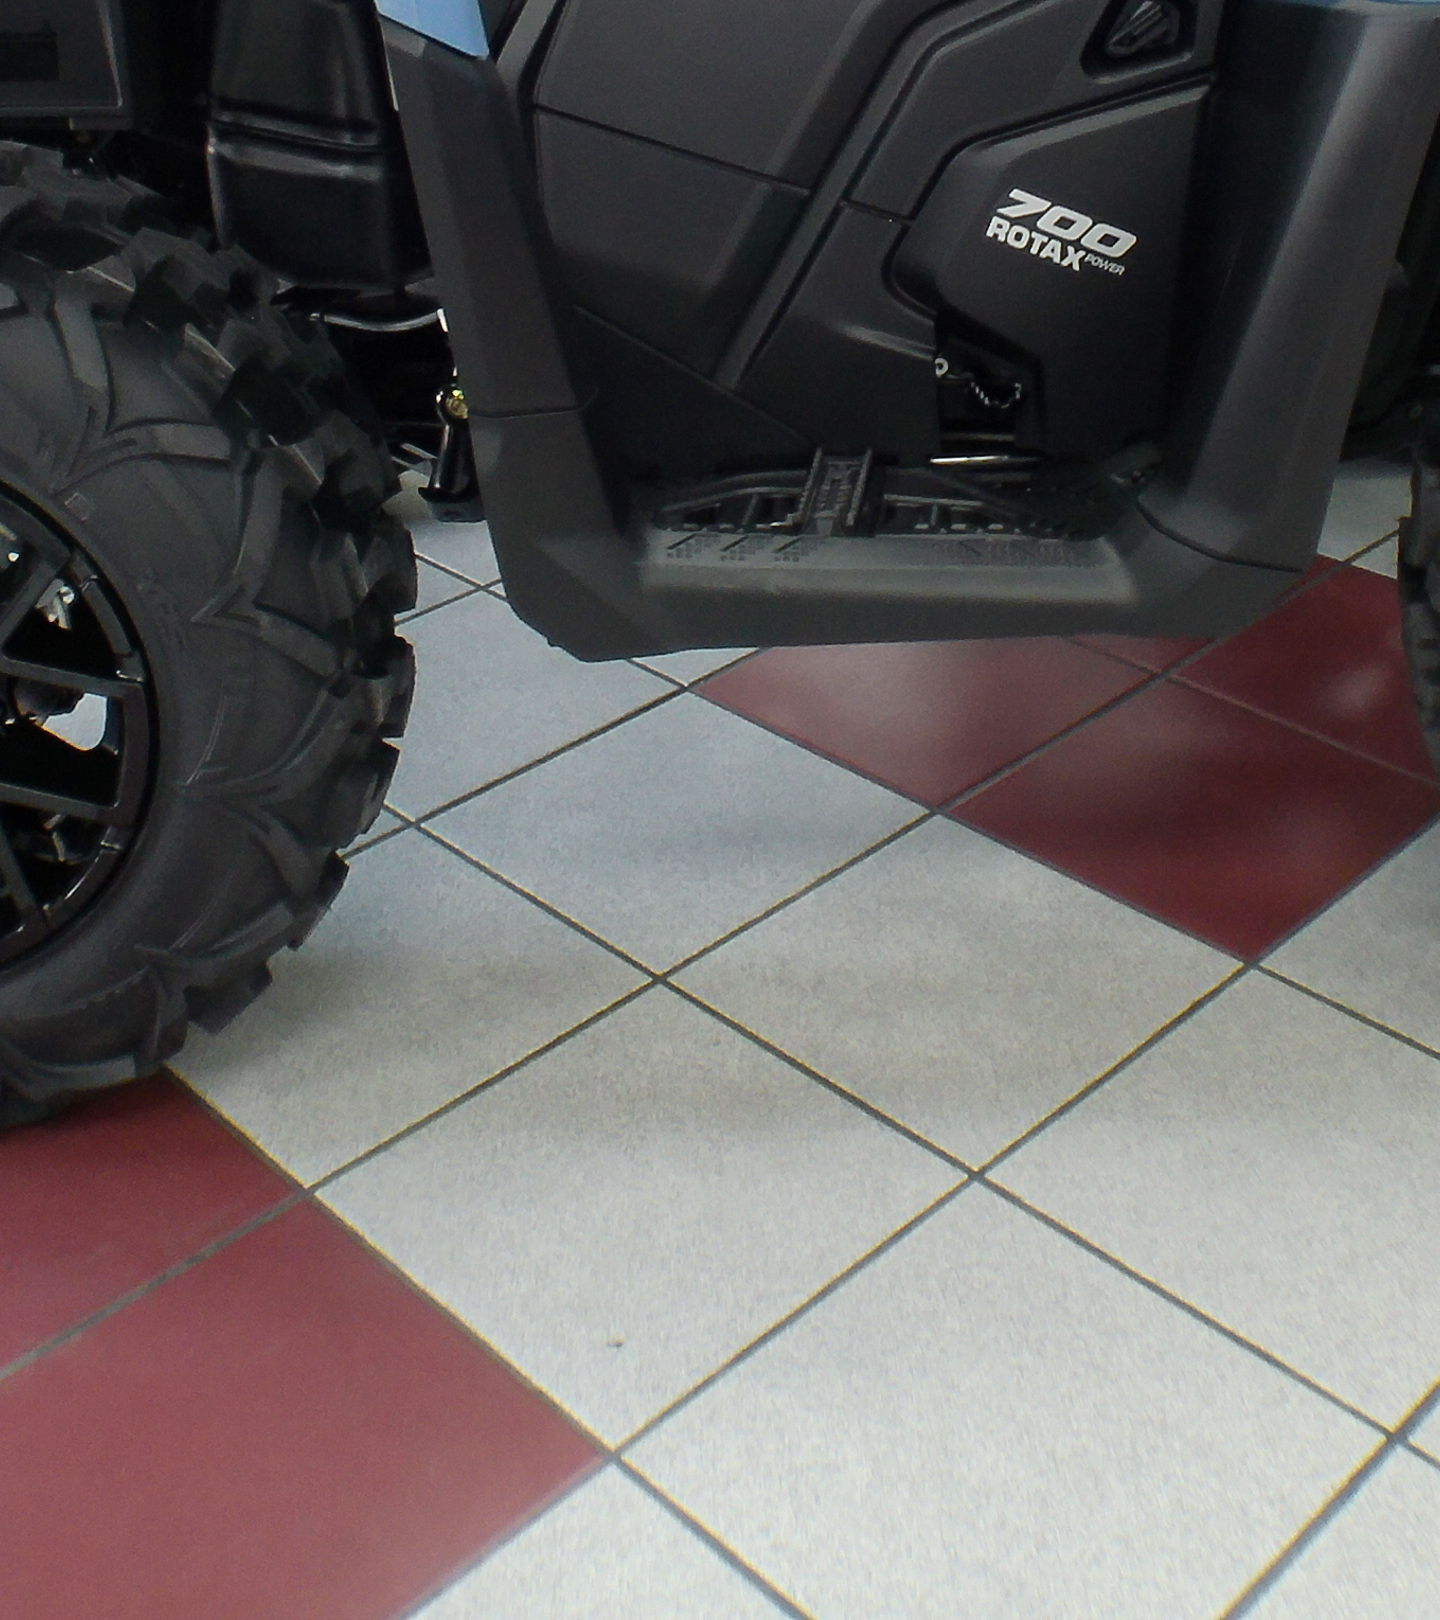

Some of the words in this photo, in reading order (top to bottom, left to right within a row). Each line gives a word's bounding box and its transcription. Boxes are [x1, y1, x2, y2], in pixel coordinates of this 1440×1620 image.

[985, 214, 1086, 272] ROTAX
[1084, 252, 1126, 276] POWER
[996, 187, 1138, 259] 700
